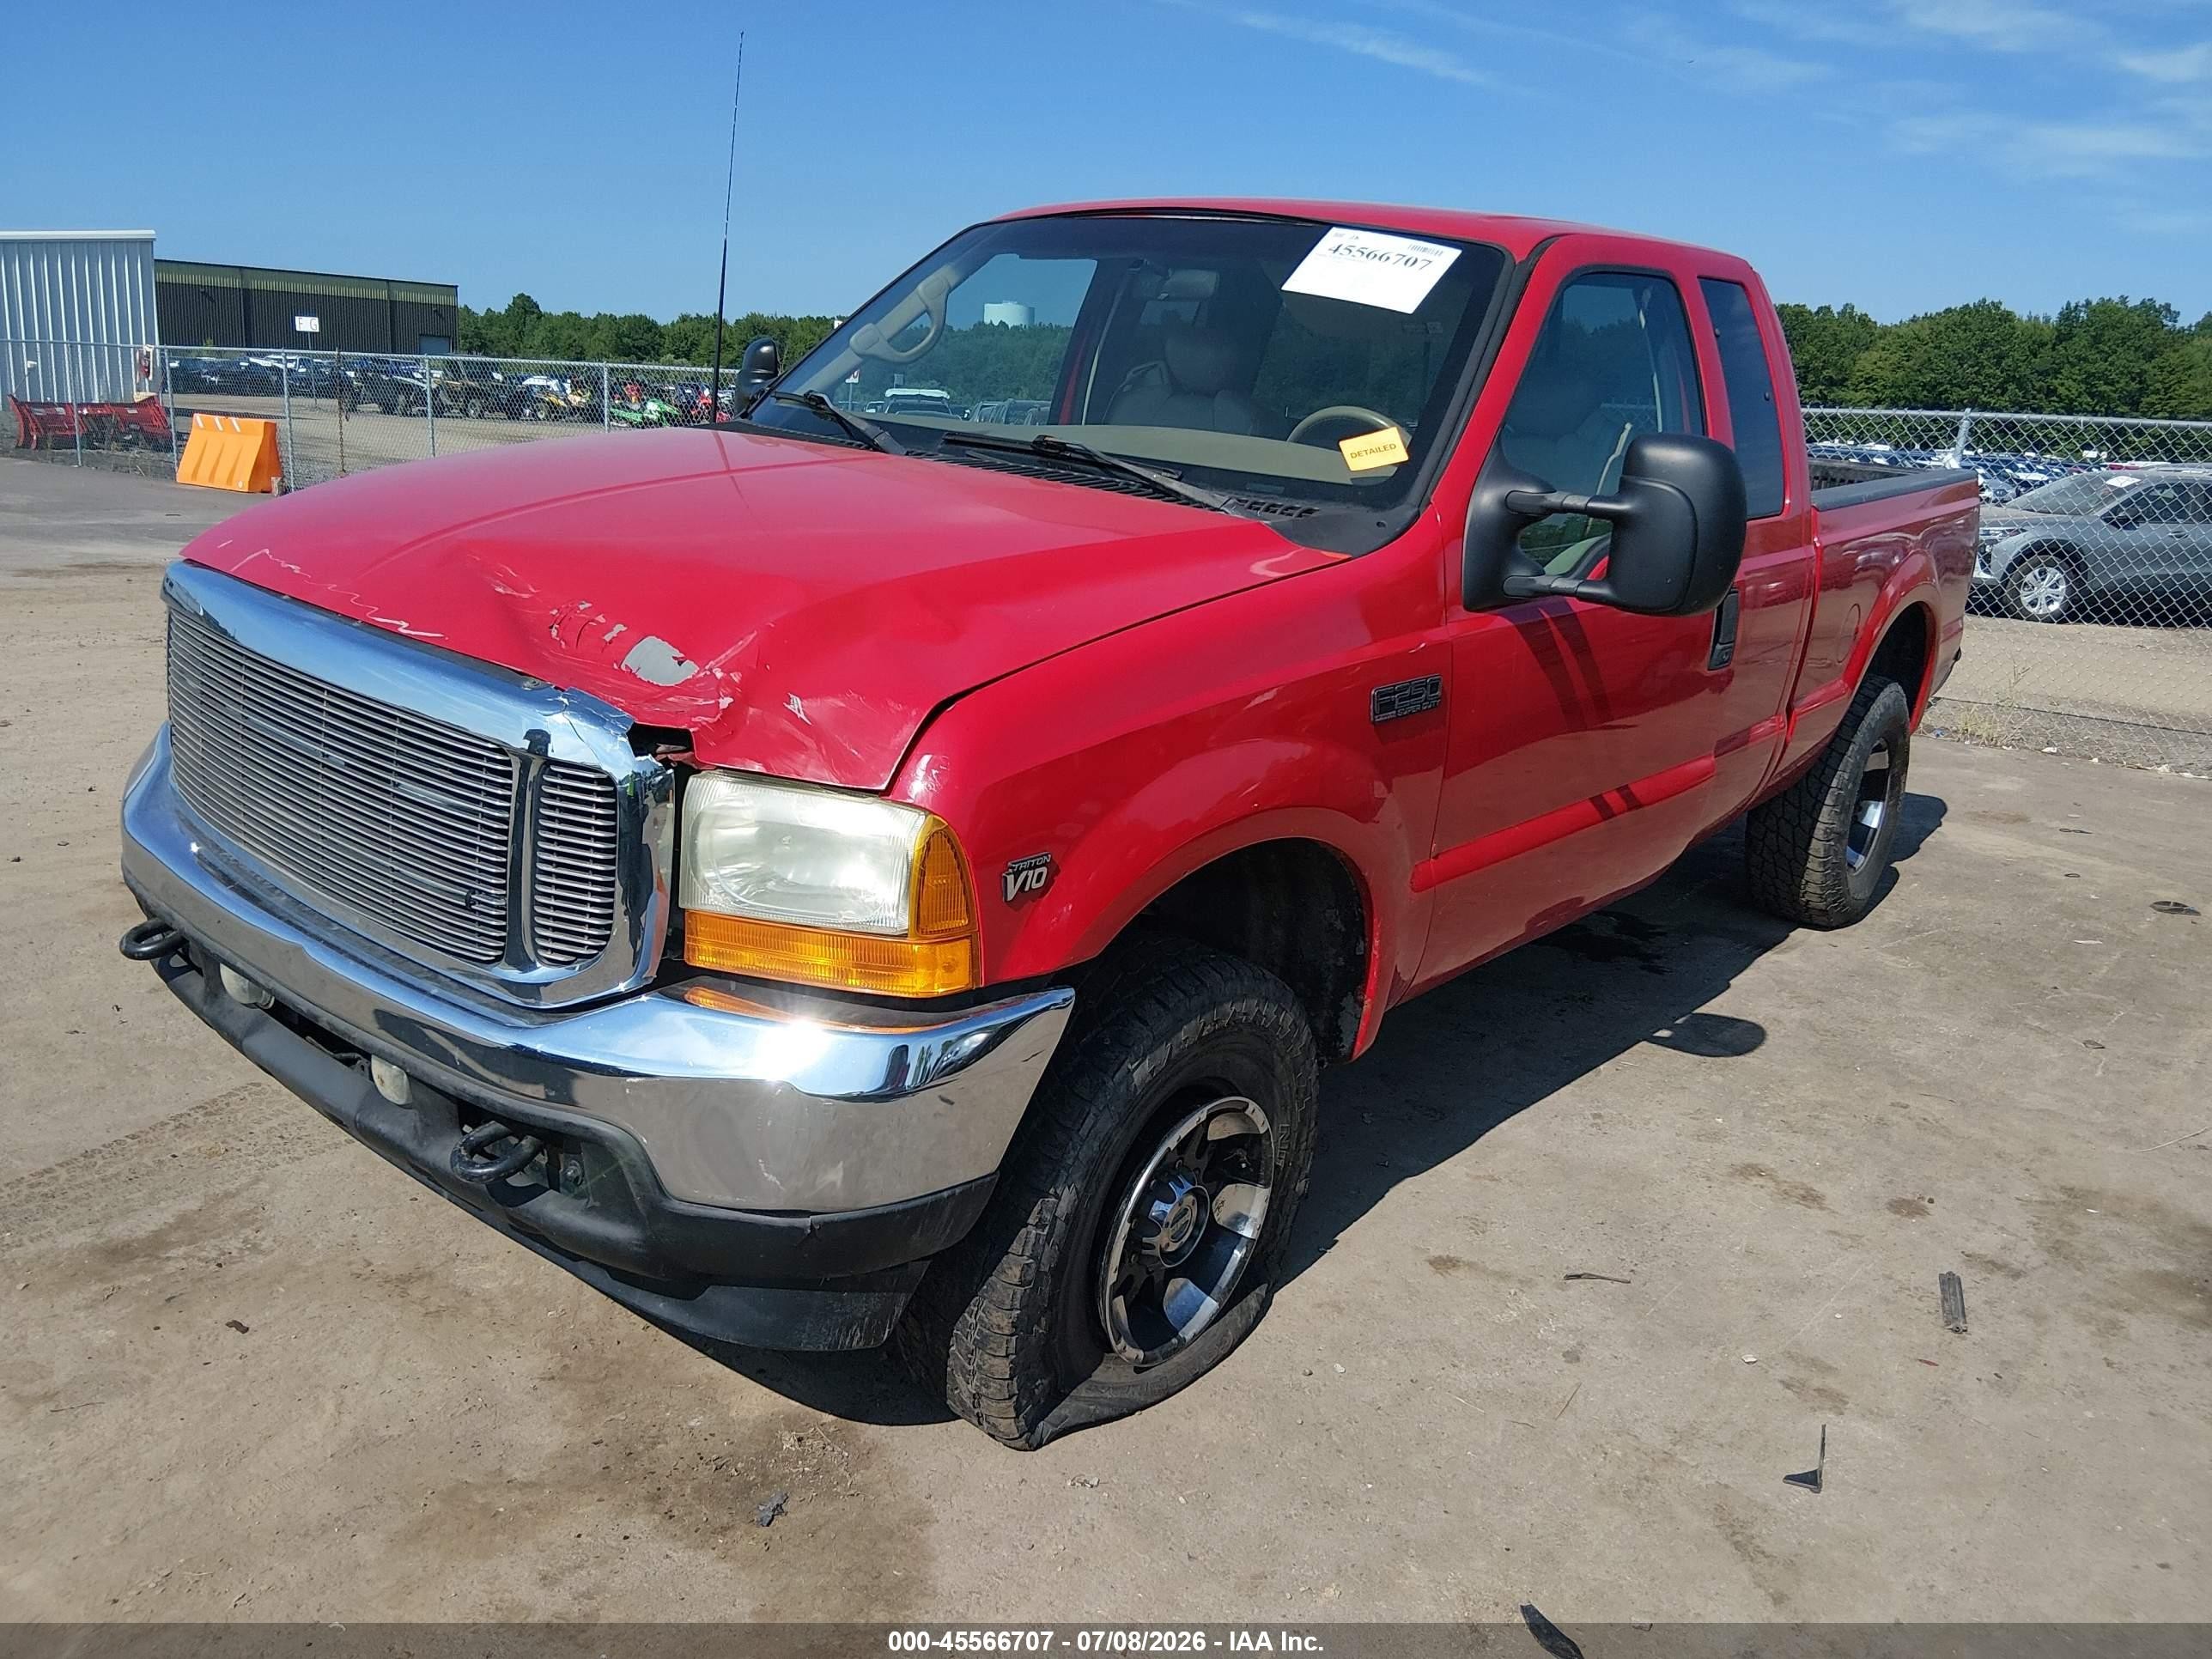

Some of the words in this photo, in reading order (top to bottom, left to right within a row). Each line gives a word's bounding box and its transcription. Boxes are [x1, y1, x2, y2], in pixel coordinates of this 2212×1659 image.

[1328, 243, 1433, 270] 45566707
[298, 317, 303, 331] F
[309, 318, 318, 331] G
[1349, 443, 1397, 459] DETAILED
[1012, 854, 1052, 872] TRITON
[1006, 866, 1048, 902] V10
